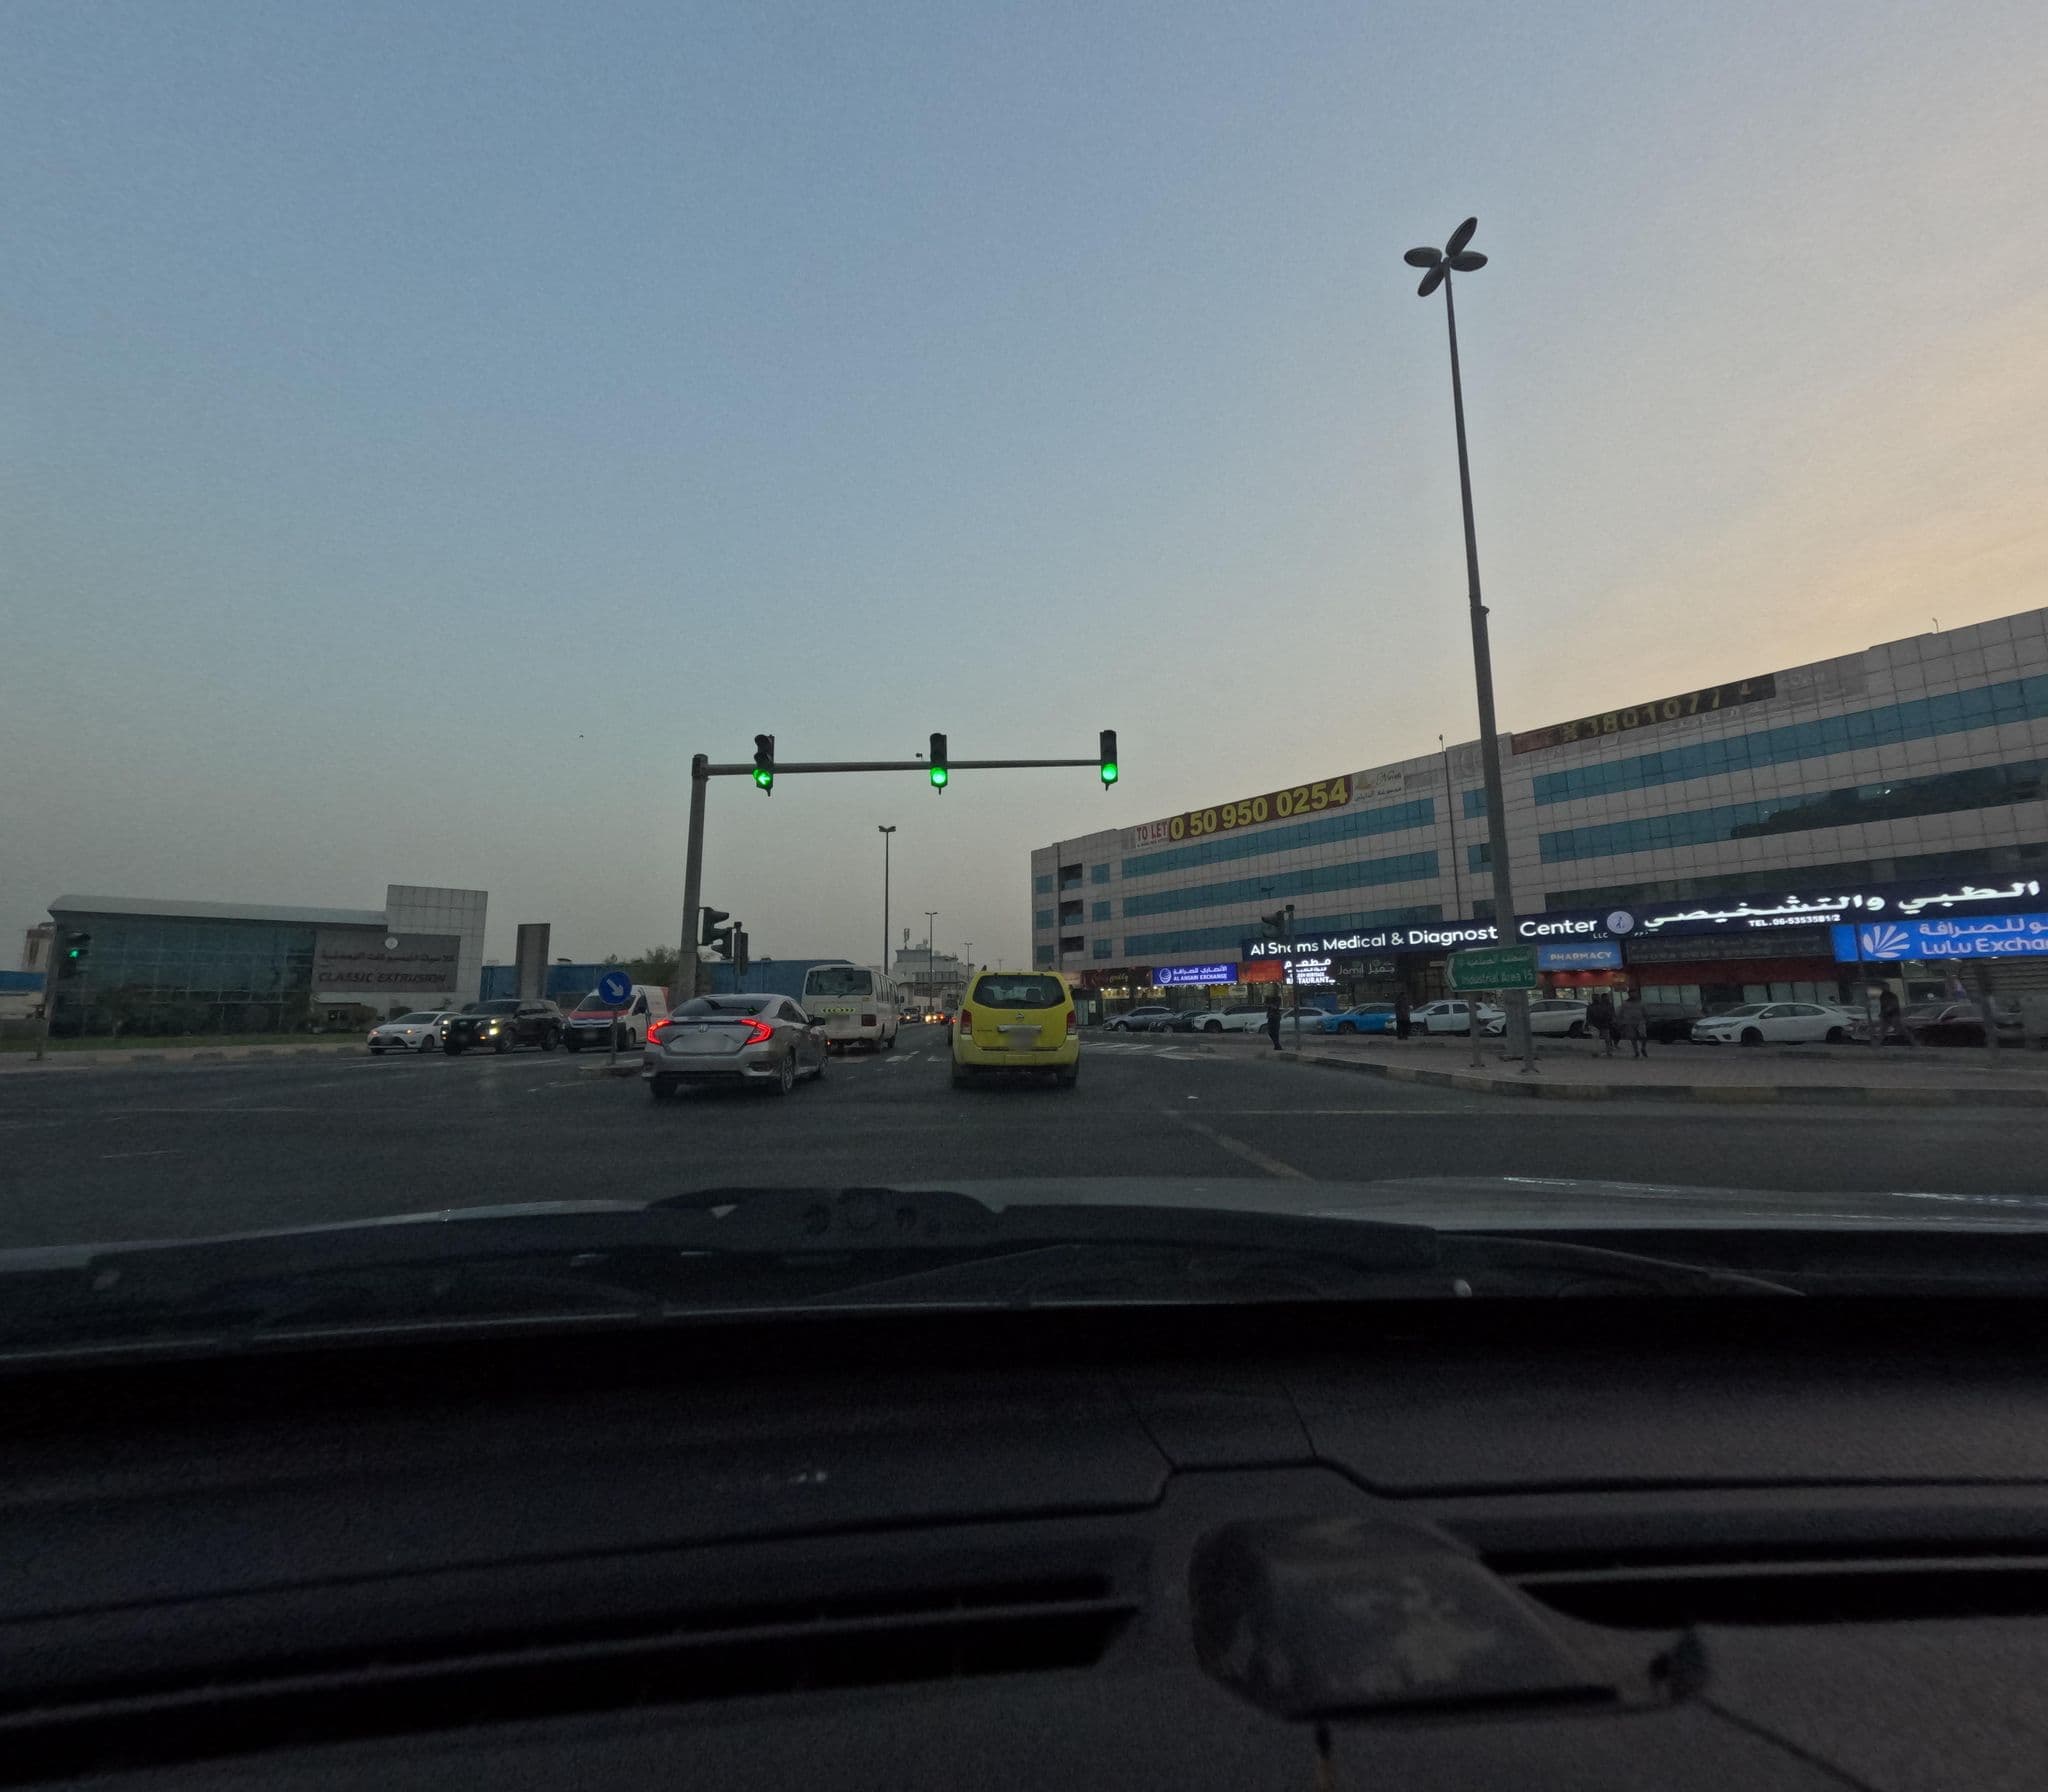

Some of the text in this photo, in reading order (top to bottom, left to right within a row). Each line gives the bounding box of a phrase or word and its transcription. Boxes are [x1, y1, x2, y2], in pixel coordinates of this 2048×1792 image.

[1136, 827, 1148, 841] TO
[1151, 821, 1167, 838] LET
[1189, 809, 1217, 836] 50
[1221, 797, 1268, 830] 950
[1275, 776, 1348, 818] 0254
[1644, 880, 2040, 932] الطبي والتشخيصي
[1251, 943, 1265, 956] Al
[1323, 933, 1386, 951] Medical
[1391, 932, 1405, 946] &
[1519, 919, 1599, 938] Center
[1919, 916, 2025, 938] للصرافة
[1975, 937, 2048, 952] Excha
[1550, 951, 1612, 961] PHARMACY
[319, 972, 447, 983] CLASSIC EXTRUSION
